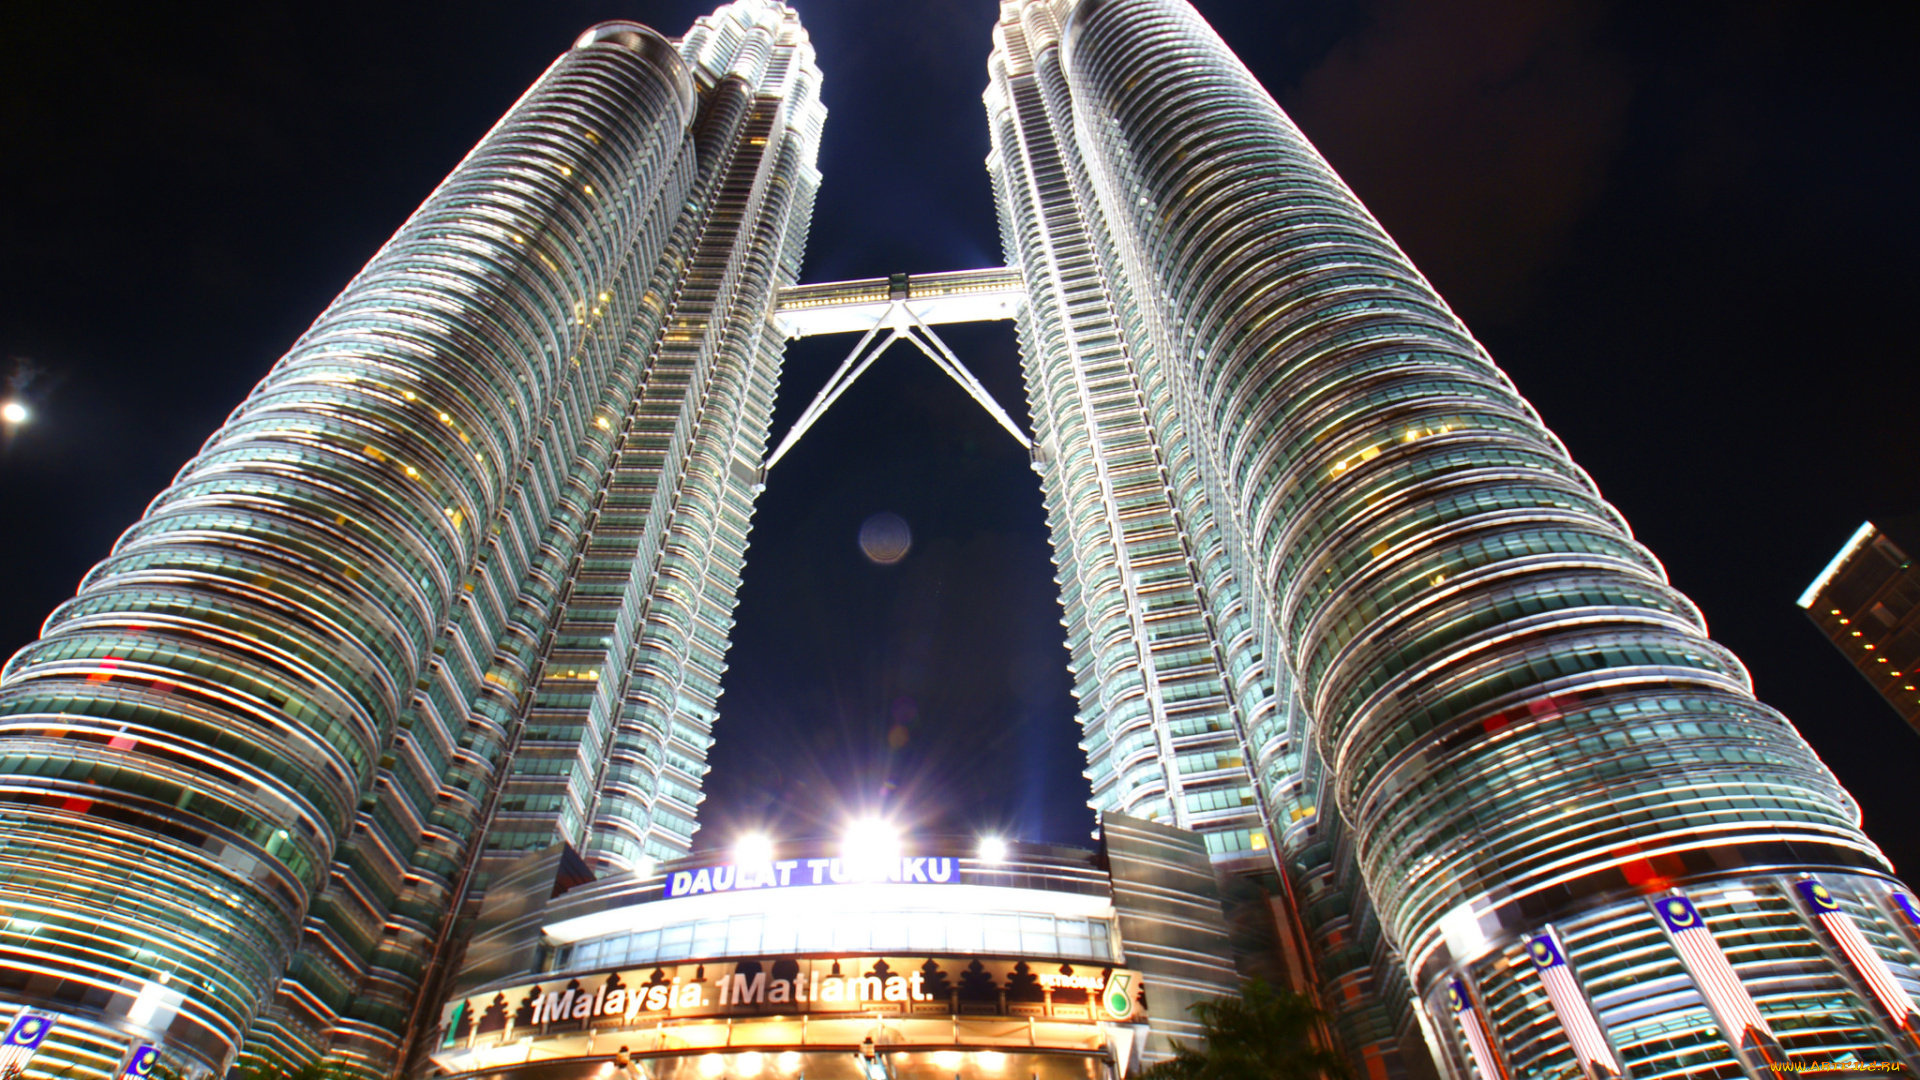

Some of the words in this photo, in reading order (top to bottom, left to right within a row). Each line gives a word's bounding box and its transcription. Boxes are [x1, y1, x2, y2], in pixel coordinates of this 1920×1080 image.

[671, 860, 797, 896] DAULAT
[531, 977, 709, 1024] 1Malaysia.
[715, 971, 933, 1005] 1Matlamat.
[1039, 974, 1104, 990] PETRONAS
